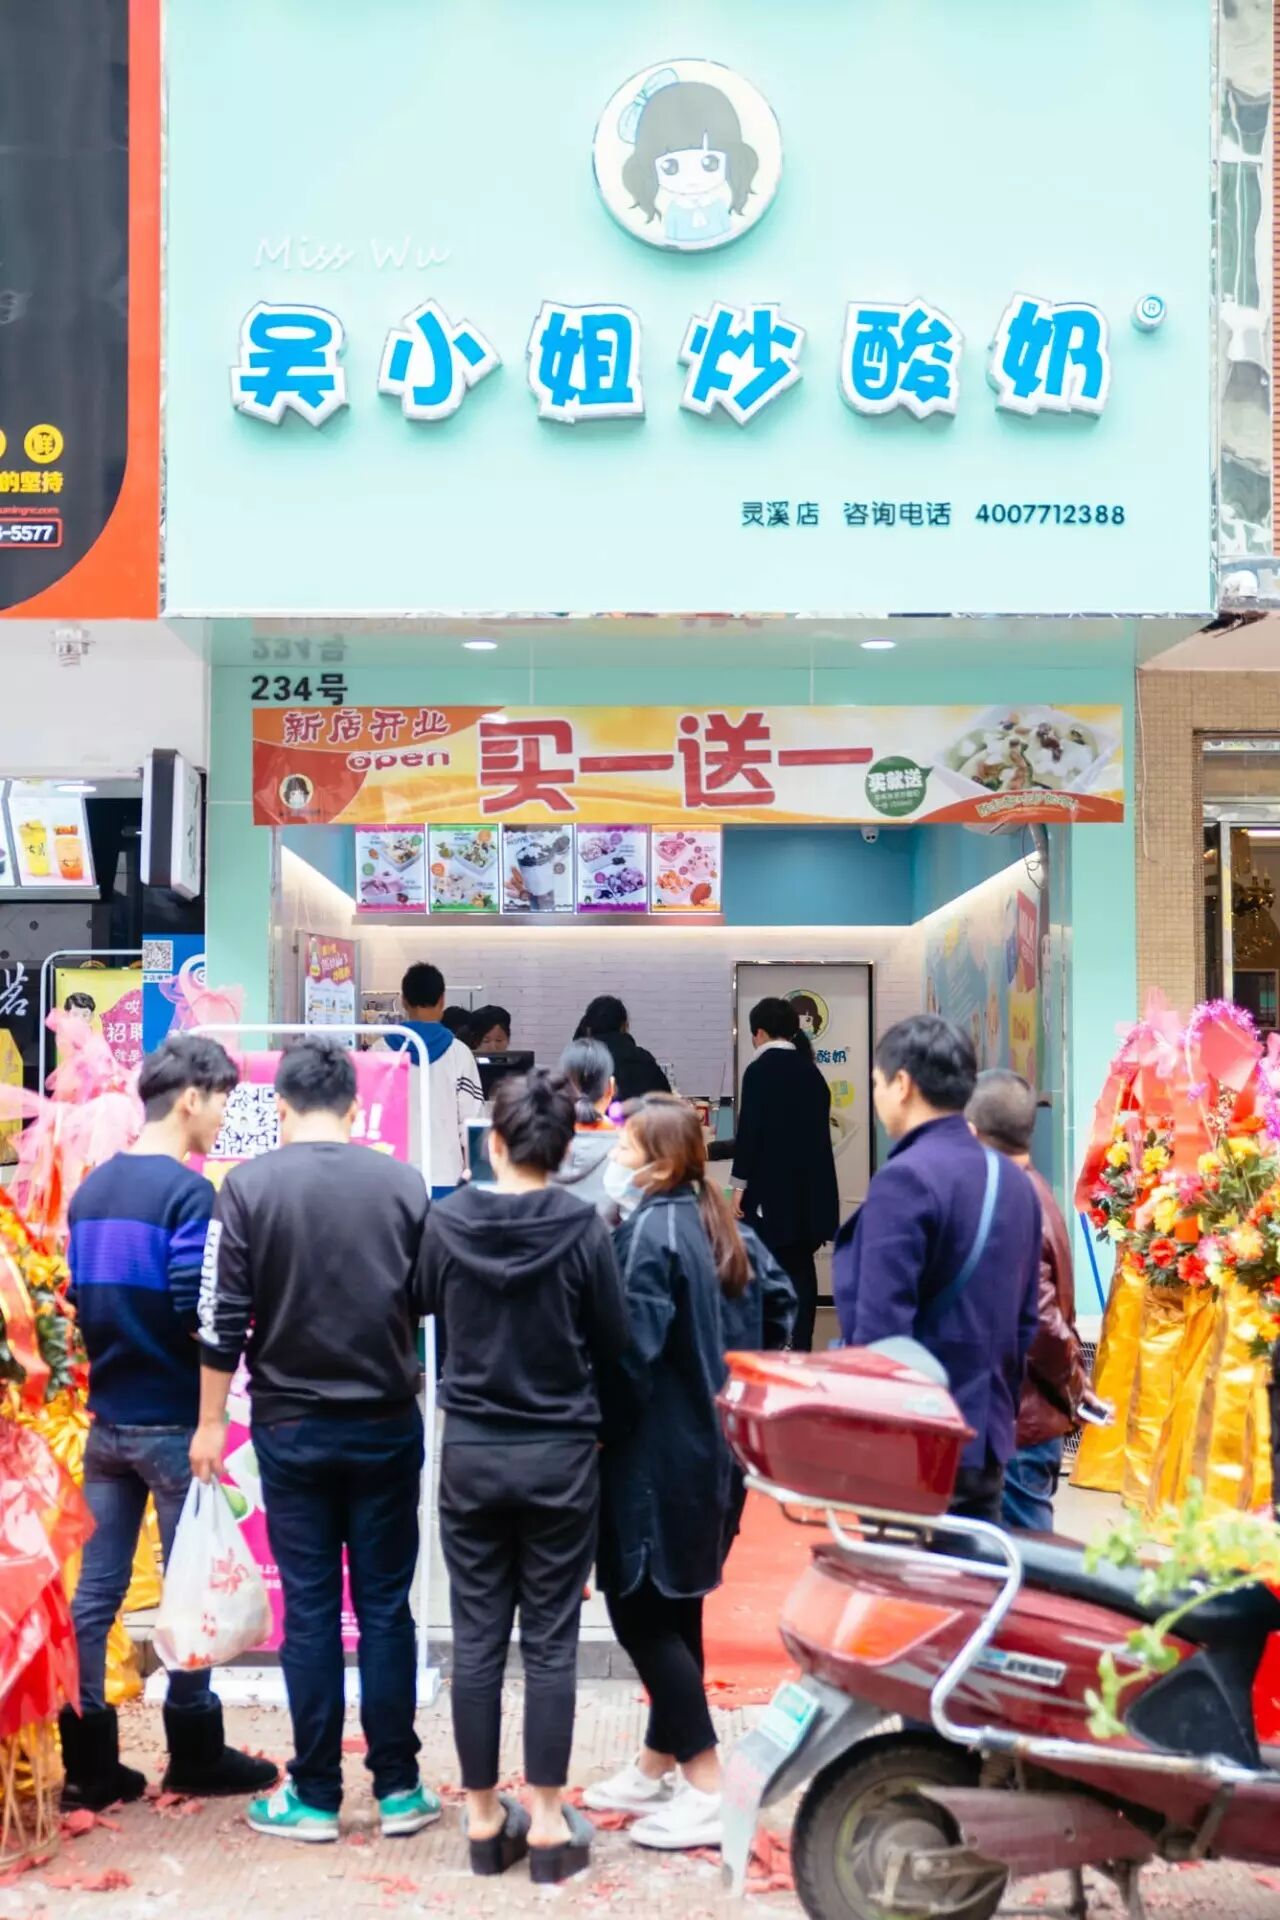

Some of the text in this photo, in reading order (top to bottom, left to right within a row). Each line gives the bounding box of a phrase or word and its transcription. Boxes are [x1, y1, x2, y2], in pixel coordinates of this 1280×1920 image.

[253, 235, 451, 271] Miss Wu
[233, 293, 1111, 424] 吴小姐炒酸奶
[741, 501, 1125, 526] 灵溪店 咨询电话 4007712388
[251, 673, 348, 706] 234号
[284, 710, 449, 744] 新店开业
[348, 751, 450, 771] open
[479, 712, 874, 814] 买一送一
